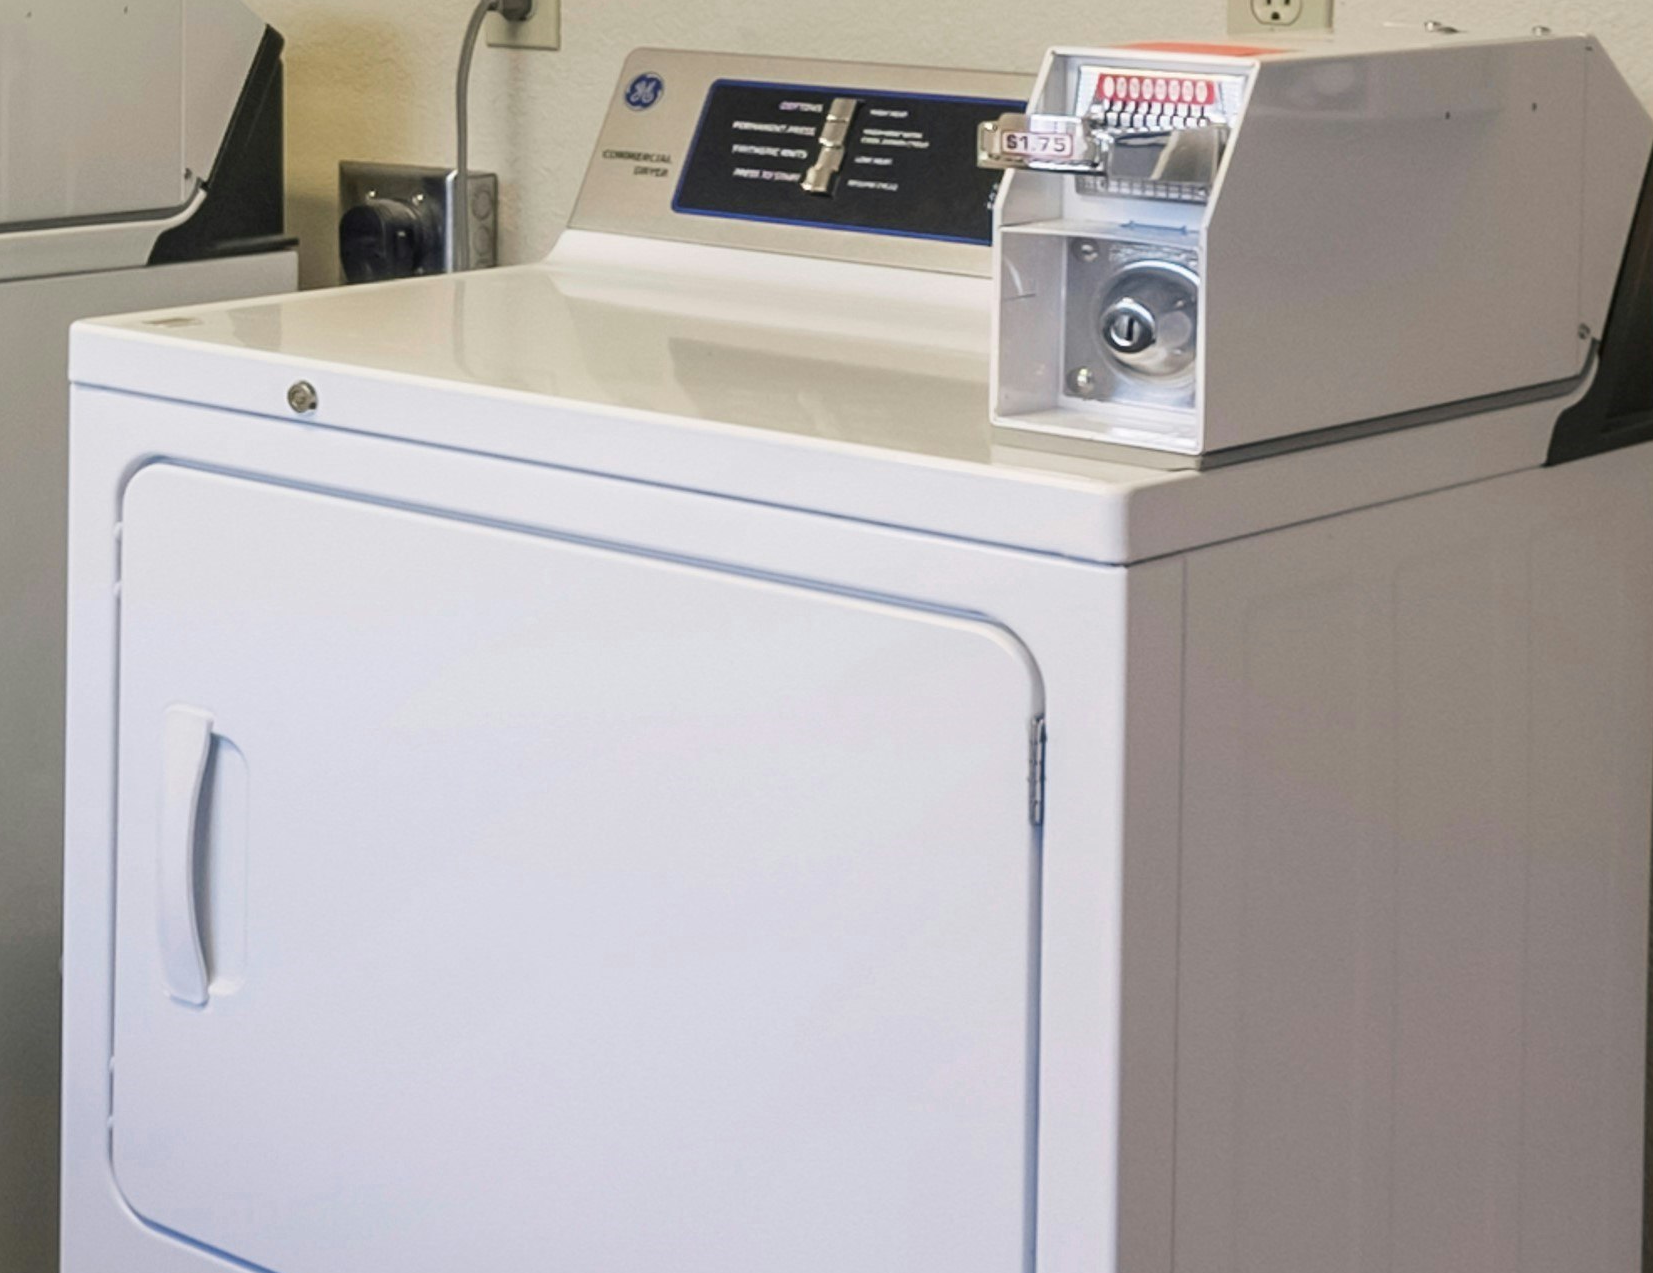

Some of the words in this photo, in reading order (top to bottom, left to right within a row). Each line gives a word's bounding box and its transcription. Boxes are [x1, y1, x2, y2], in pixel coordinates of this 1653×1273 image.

[1005, 133, 1066, 154] $1.75
[602, 149, 672, 164] COMMERCIAL
[633, 166, 669, 178] DRYER
